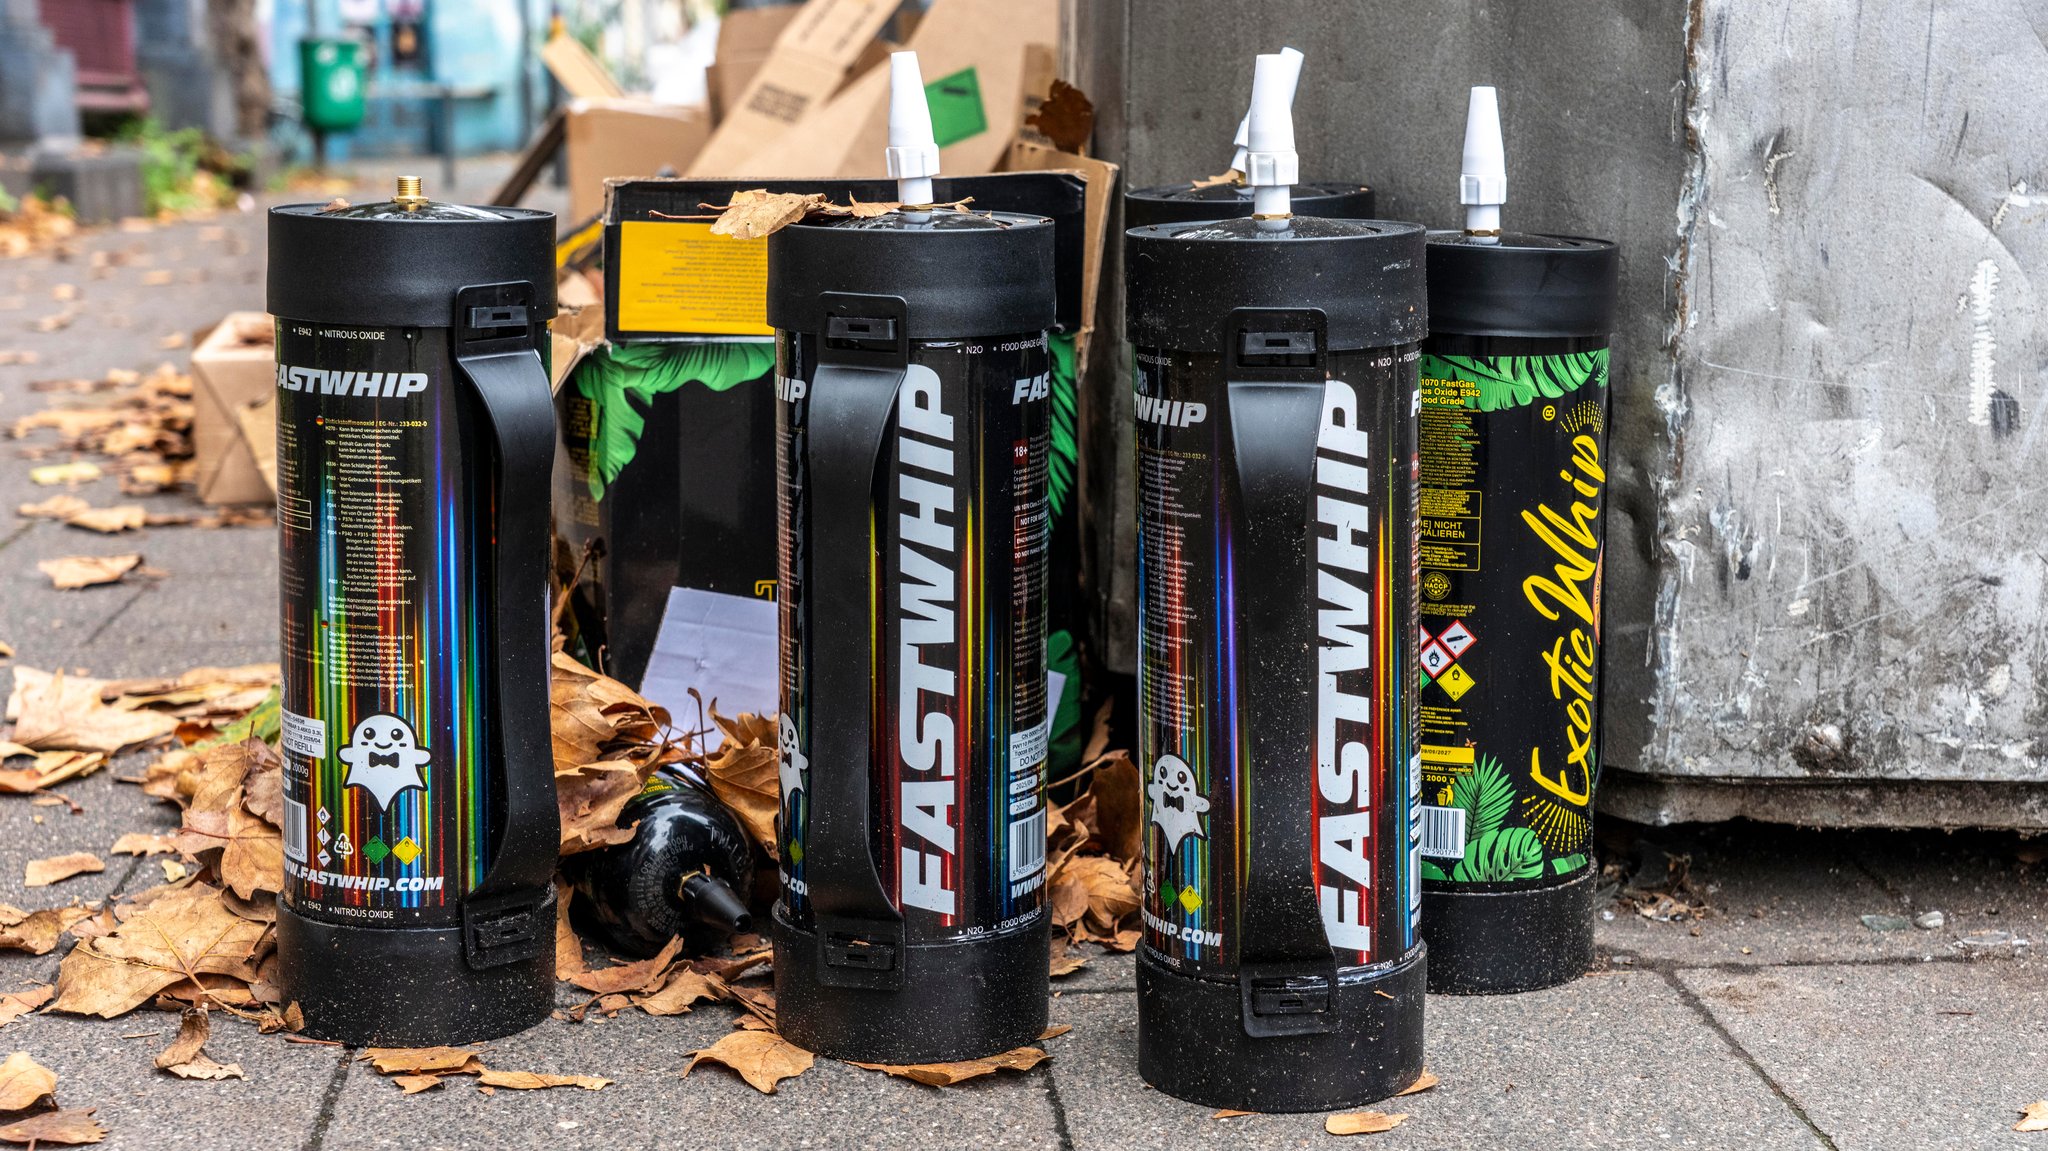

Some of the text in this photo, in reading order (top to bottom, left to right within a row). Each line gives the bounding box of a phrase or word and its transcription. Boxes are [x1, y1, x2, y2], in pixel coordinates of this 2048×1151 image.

[298, 327, 386, 340] E942 NITROUS OXIDE
[966, 345, 983, 355] N2O
[1001, 342, 1019, 352] FOOD
[1020, 339, 1035, 350] GRADE
[1378, 357, 1391, 367] N2O
[1421, 378, 1476, 388] 1070 FastGas
[1434, 387, 1458, 397] Oxide
[1460, 388, 1481, 397] E942
[1440, 396, 1465, 405] Grade
[399, 420, 428, 428] 233-032-0
[1014, 446, 1028, 458] 18+
[1434, 520, 1462, 530] NICHT
[1521, 434, 1606, 626] Whip
[1424, 581, 1448, 589] HACCP
[898, 363, 955, 916] FASTWHIP
[1317, 379, 1370, 951] FASTWHIP
[294, 740, 315, 754] REFILL
[1020, 756, 1030, 767] DO
[1426, 774, 1447, 783] 2000
[308, 902, 394, 919] E942 NITROUS OXIDE
[967, 926, 984, 934] N2O
[1001, 917, 1019, 929] FOOD
